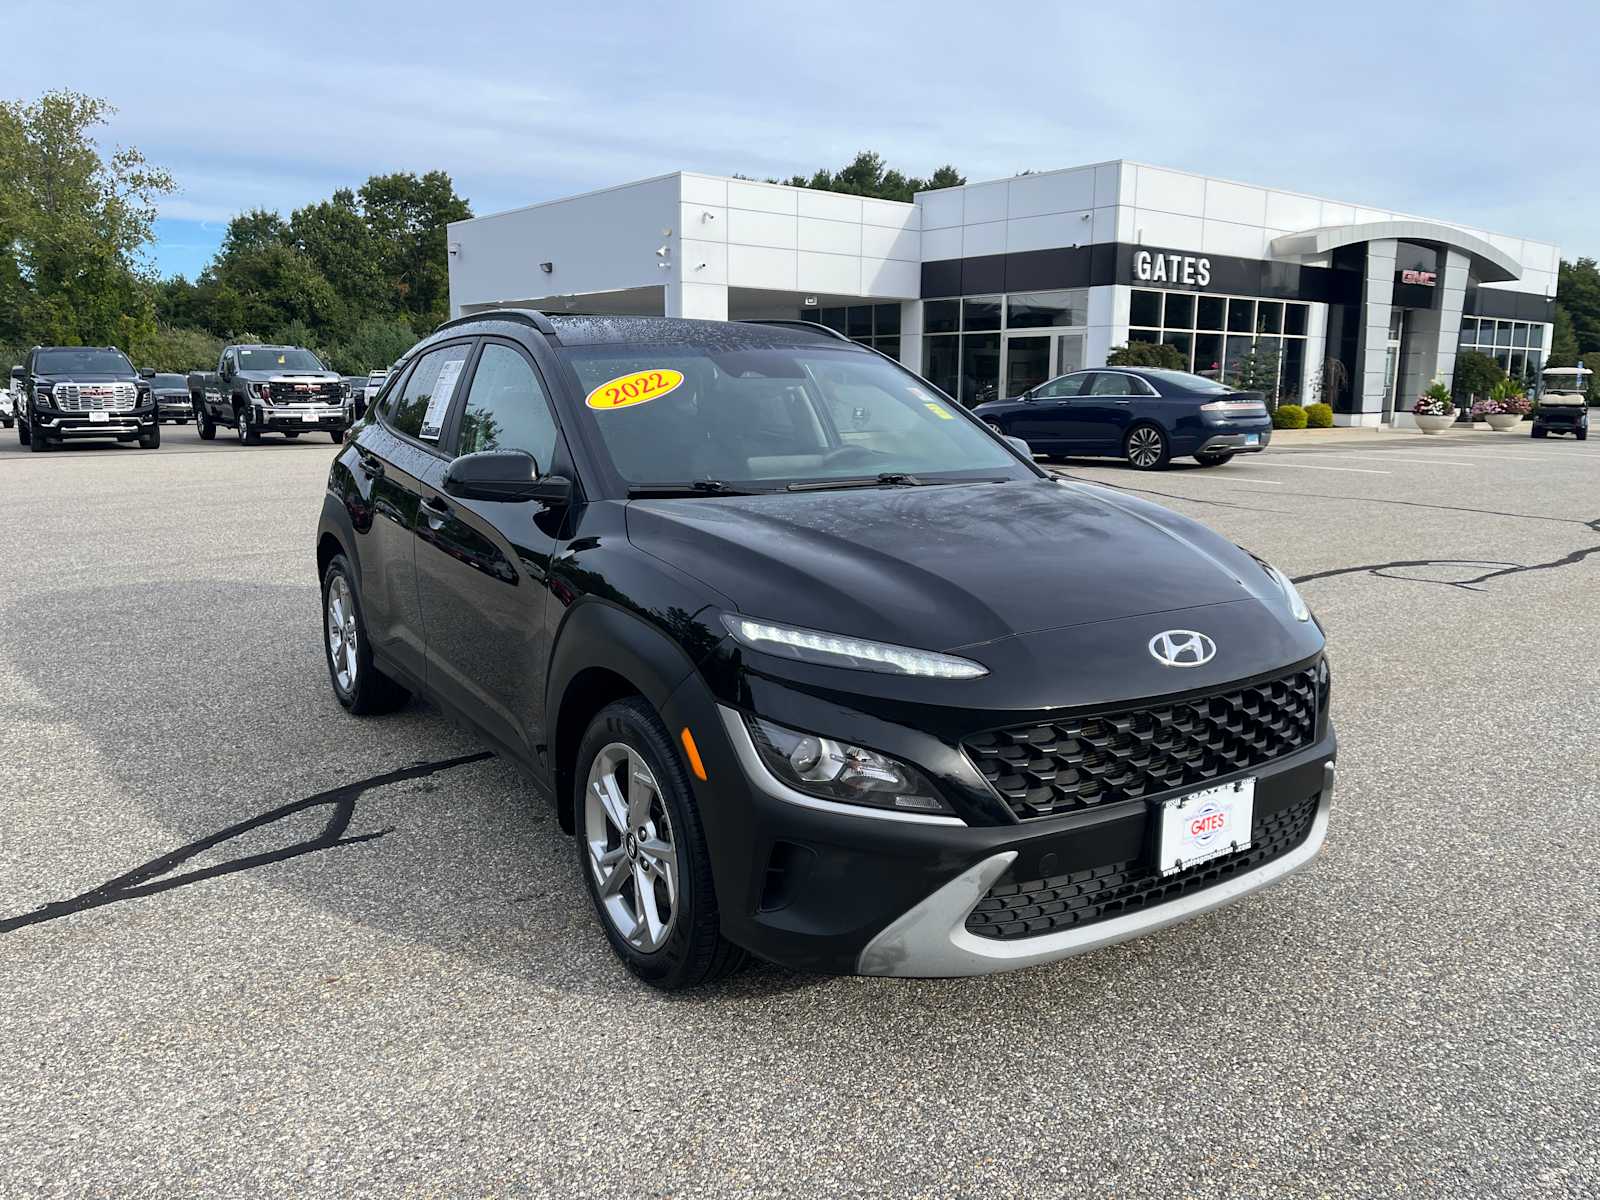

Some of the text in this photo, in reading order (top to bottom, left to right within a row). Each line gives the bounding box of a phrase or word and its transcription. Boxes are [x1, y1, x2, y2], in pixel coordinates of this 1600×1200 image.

[1135, 250, 1211, 287] GATES
[1402, 270, 1437, 286] GMC
[605, 373, 669, 404] 2022
[1191, 813, 1225, 836] GATES
